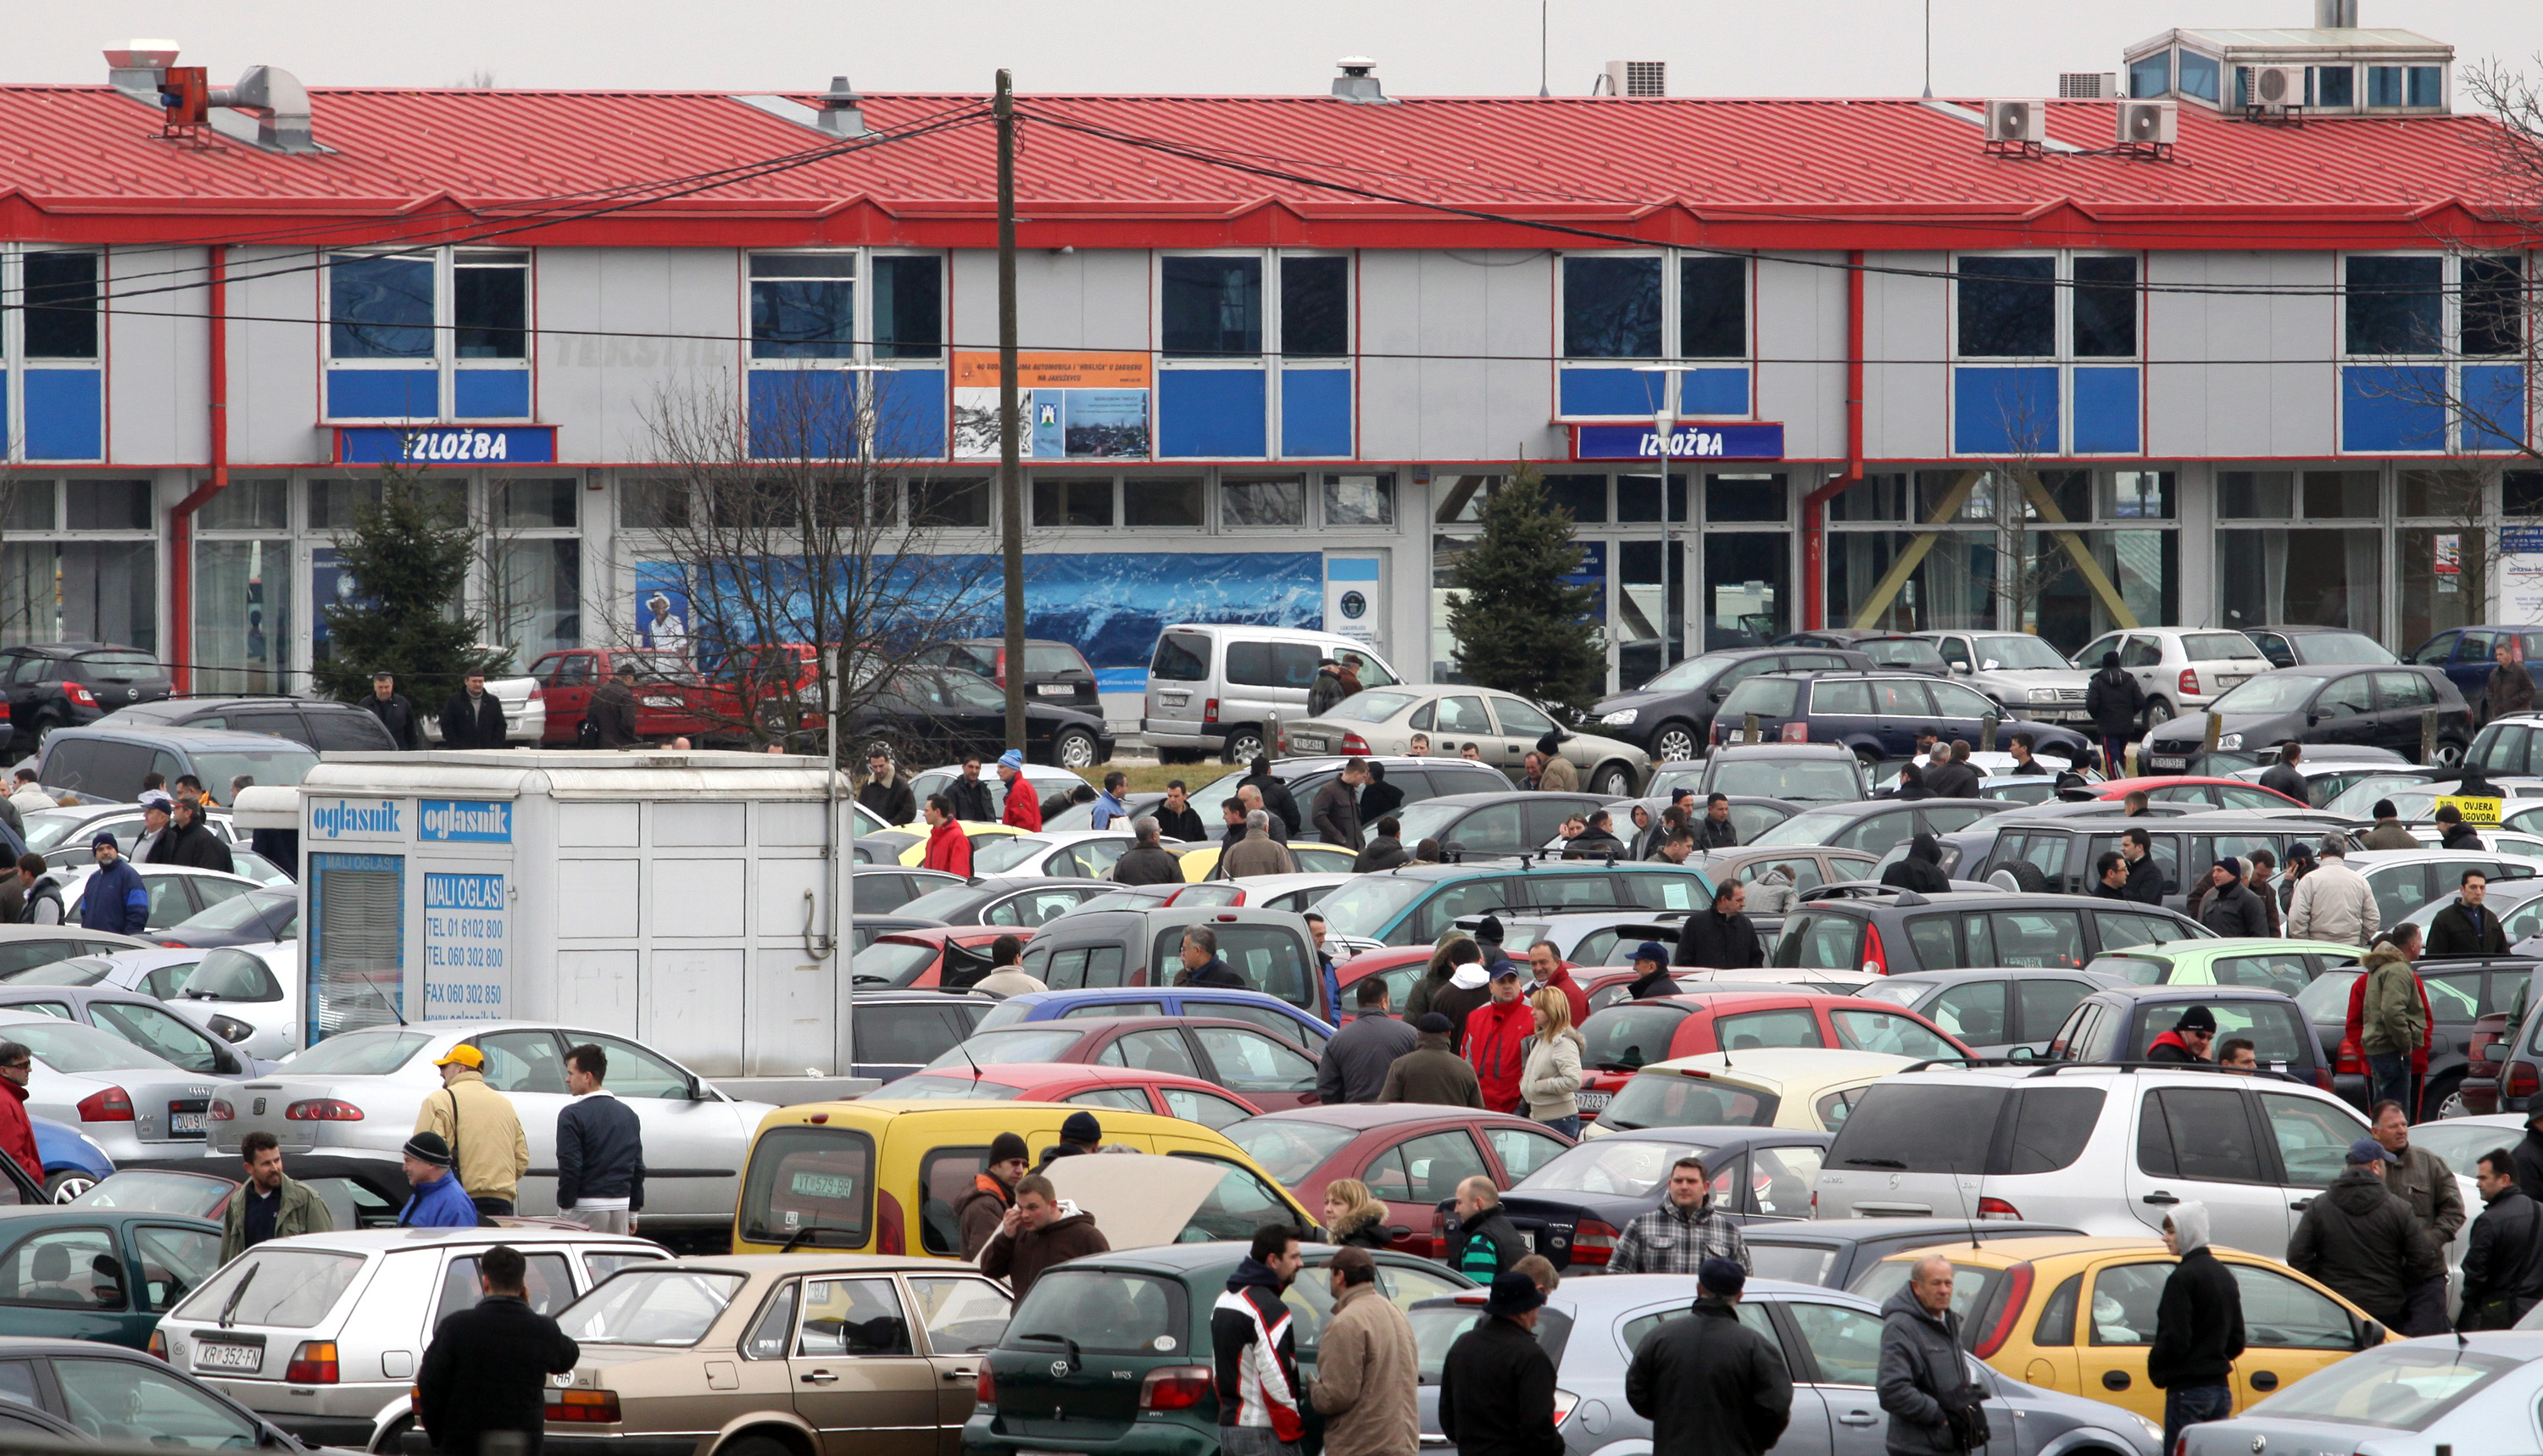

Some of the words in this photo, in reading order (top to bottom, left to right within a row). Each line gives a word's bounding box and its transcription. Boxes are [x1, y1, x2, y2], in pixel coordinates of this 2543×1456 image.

[403, 428, 507, 460] IZLOŽBA
[2461, 812, 2496, 821] UGOVORA
[2463, 802, 2493, 811] OVJERA
[314, 800, 401, 838] oglasnik
[425, 803, 508, 840] oglasnik
[326, 855, 353, 869] MALI
[354, 856, 393, 870] OGLASI
[426, 878, 455, 906] MALI
[458, 878, 503, 908] OGLASI
[427, 917, 445, 936] TEL
[448, 918, 458, 937] 01
[462, 919, 484, 938] 6102
[487, 919, 503, 938] 800
[427, 946, 445, 965] TEL
[448, 947, 464, 966] 060
[467, 947, 484, 967] 302
[486, 948, 503, 967] 800
[426, 983, 444, 1003] FAX
[447, 984, 464, 1003] 060
[466, 984, 482, 1003] 302
[485, 985, 501, 1003] 850
[177, 1114, 189, 1129] DU
[799, 1175, 810, 1189] VT
[815, 1177, 850, 1195] 579-BR
[203, 1346, 217, 1364] KR
[222, 1348, 260, 1366] 352-FN
[556, 1373, 570, 1383] HR
